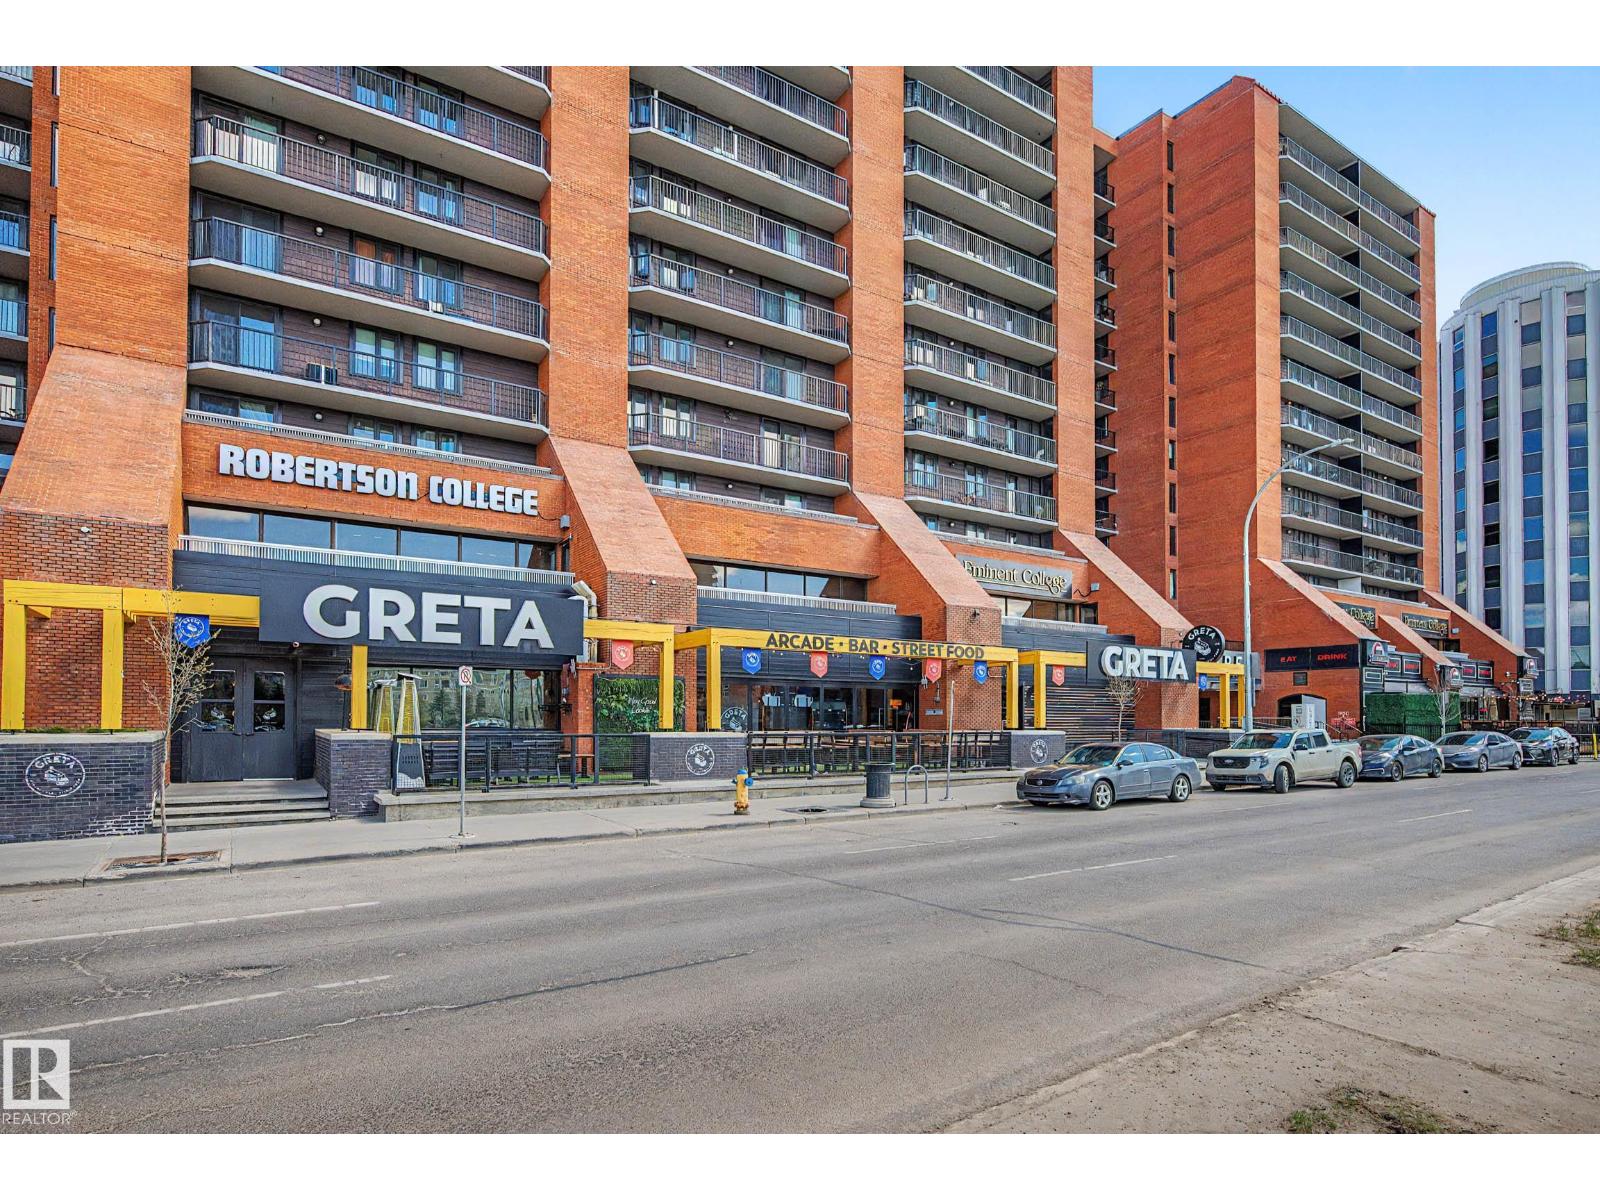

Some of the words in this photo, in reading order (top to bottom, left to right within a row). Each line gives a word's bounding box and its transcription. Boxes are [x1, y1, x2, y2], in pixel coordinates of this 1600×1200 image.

[219, 443, 418, 501] ROBERTSON
[429, 475, 539, 516] COLLEGE
[963, 560, 1018, 583] Eminent
[1022, 568, 1068, 595] College
[303, 584, 555, 649] GRETA
[766, 633, 834, 651] ARCADE
[849, 639, 879, 654] BAR
[892, 641, 944, 658] STREET
[947, 645, 985, 660] FOOD
[1188, 627, 1216, 640] GRETA
[1100, 645, 1190, 681] GRETA
[1280, 655, 1297, 663] EAT
[1317, 652, 1348, 661] DRINK
[34, 755, 76, 769] GRETA
